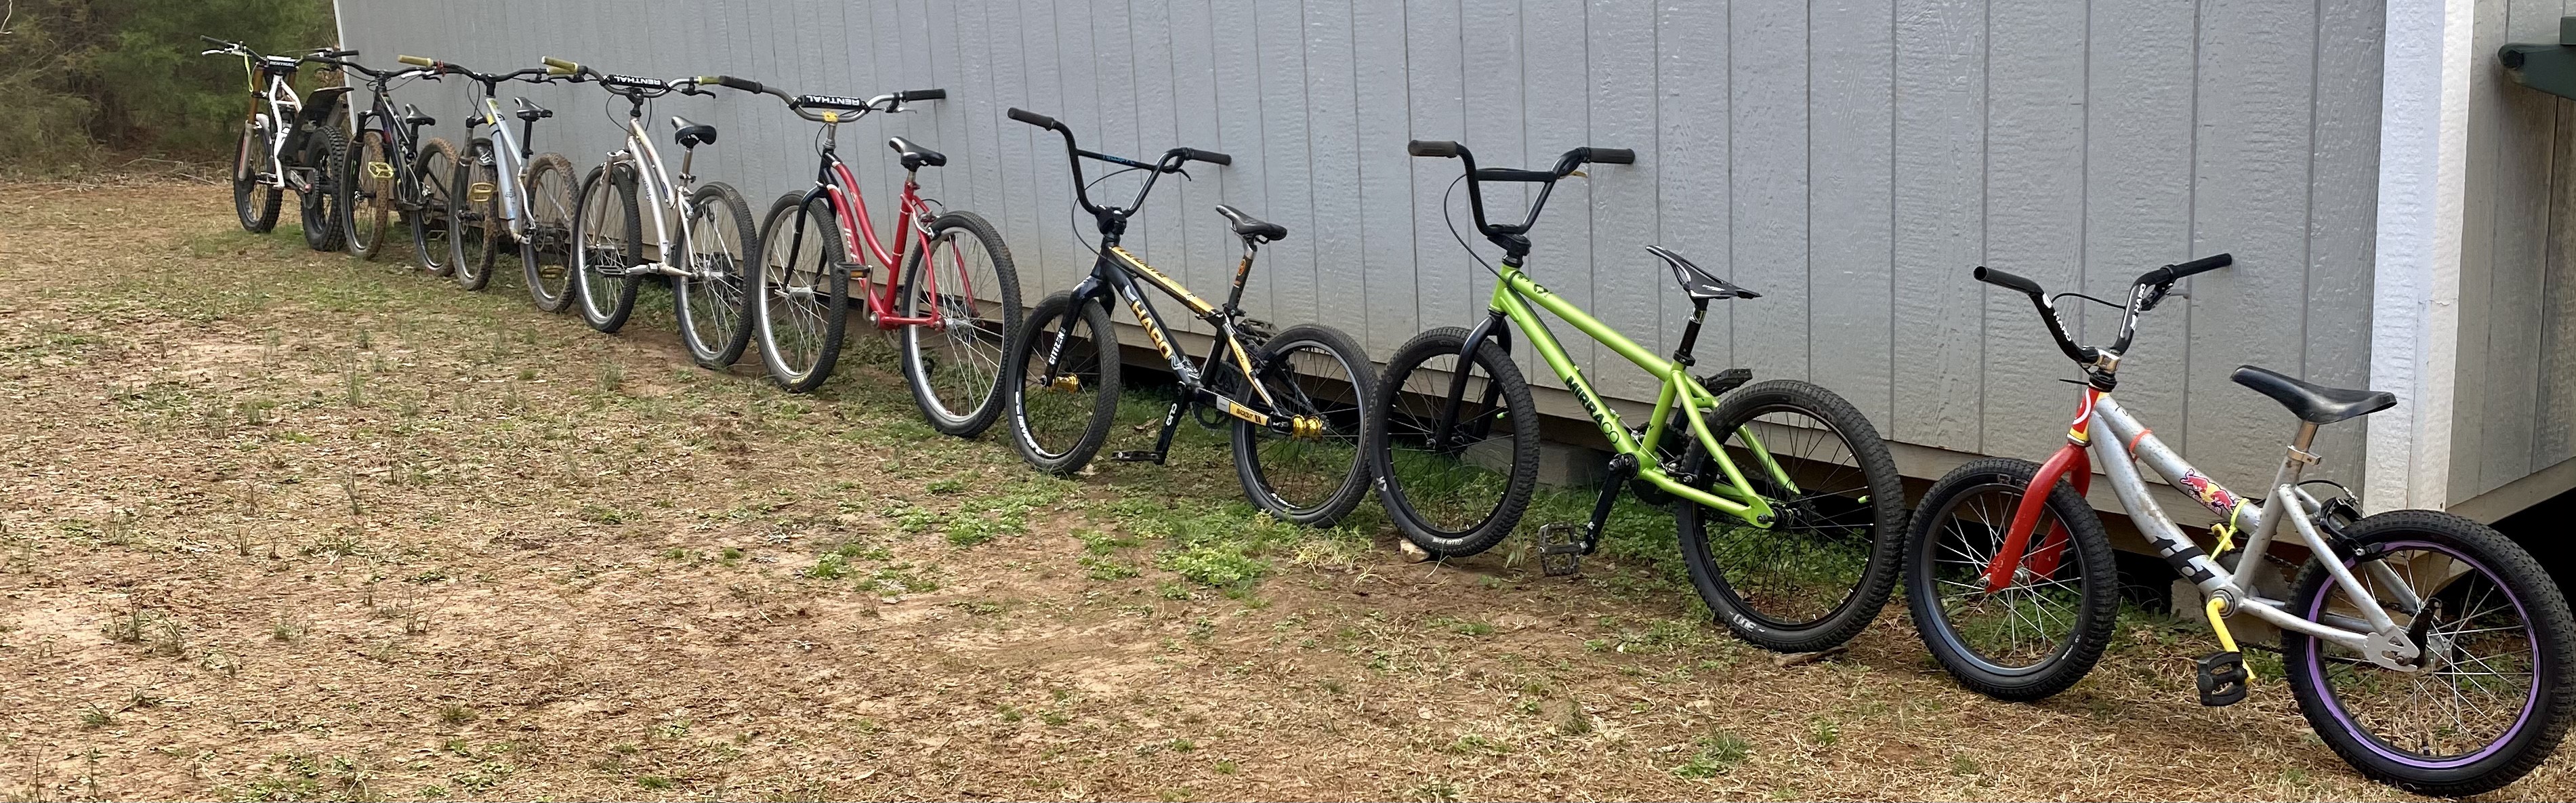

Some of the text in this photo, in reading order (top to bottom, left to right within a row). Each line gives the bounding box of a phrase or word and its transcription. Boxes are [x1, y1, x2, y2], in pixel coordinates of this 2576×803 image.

[614, 76, 661, 85] RENTHAL
[806, 95, 860, 106] RENTHAL
[2134, 283, 2146, 313] HARO
[1131, 300, 1173, 360] HARO
[2053, 311, 2072, 342] HARO
[1048, 331, 1065, 365] CITIZEN
[1565, 375, 1619, 444] MIRRACO
